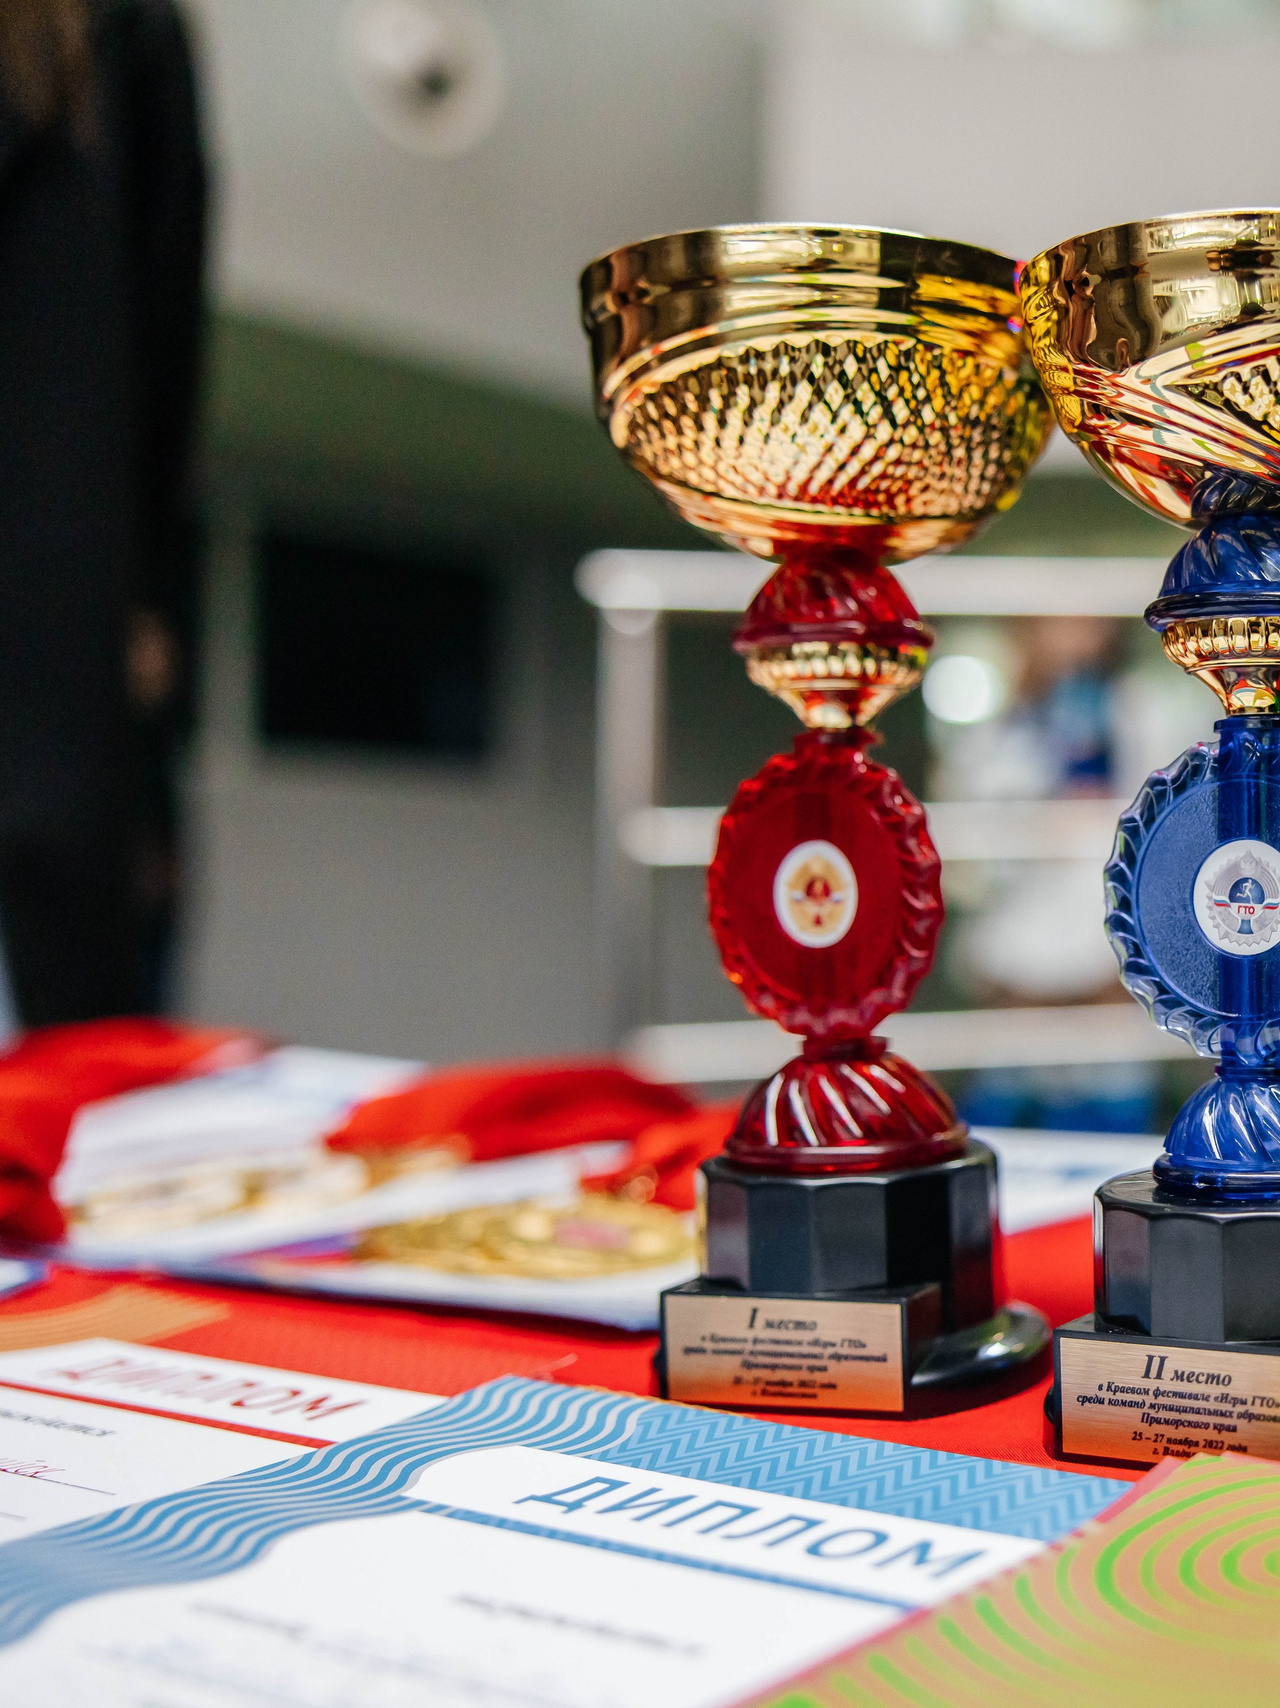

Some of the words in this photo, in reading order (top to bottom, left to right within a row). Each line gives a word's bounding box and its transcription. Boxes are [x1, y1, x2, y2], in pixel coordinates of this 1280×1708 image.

[1237, 905, 1255, 915] ГТО
[748, 1307, 759, 1329] I
[1141, 1354, 1168, 1380] II
[1170, 1369, 1231, 1386] место
[1098, 1383, 1103, 1391] в
[1106, 1381, 1149, 1395] Краевом
[1153, 1386, 1210, 1402] фестивале
[1213, 1393, 1247, 1407] «Игры
[1250, 1396, 1280, 1409] ГТО»
[1076, 1394, 1105, 1406] среди
[1108, 1398, 1146, 1410] команд
[1148, 1402, 1234, 1419] муниципальных
[1140, 1412, 1210, 1430] Приморского
[1212, 1423, 1238, 1434] края
[1131, 1431, 1143, 1441] 25
[1153, 1433, 1165, 1443] 27
[1166, 1437, 1199, 1448] ноября
[1202, 1438, 1224, 1450] 2022
[1226, 1443, 1248, 1453] года
[1152, 1447, 1159, 1455] г.
[513, 1476, 987, 1580] ДИПЛОМ
